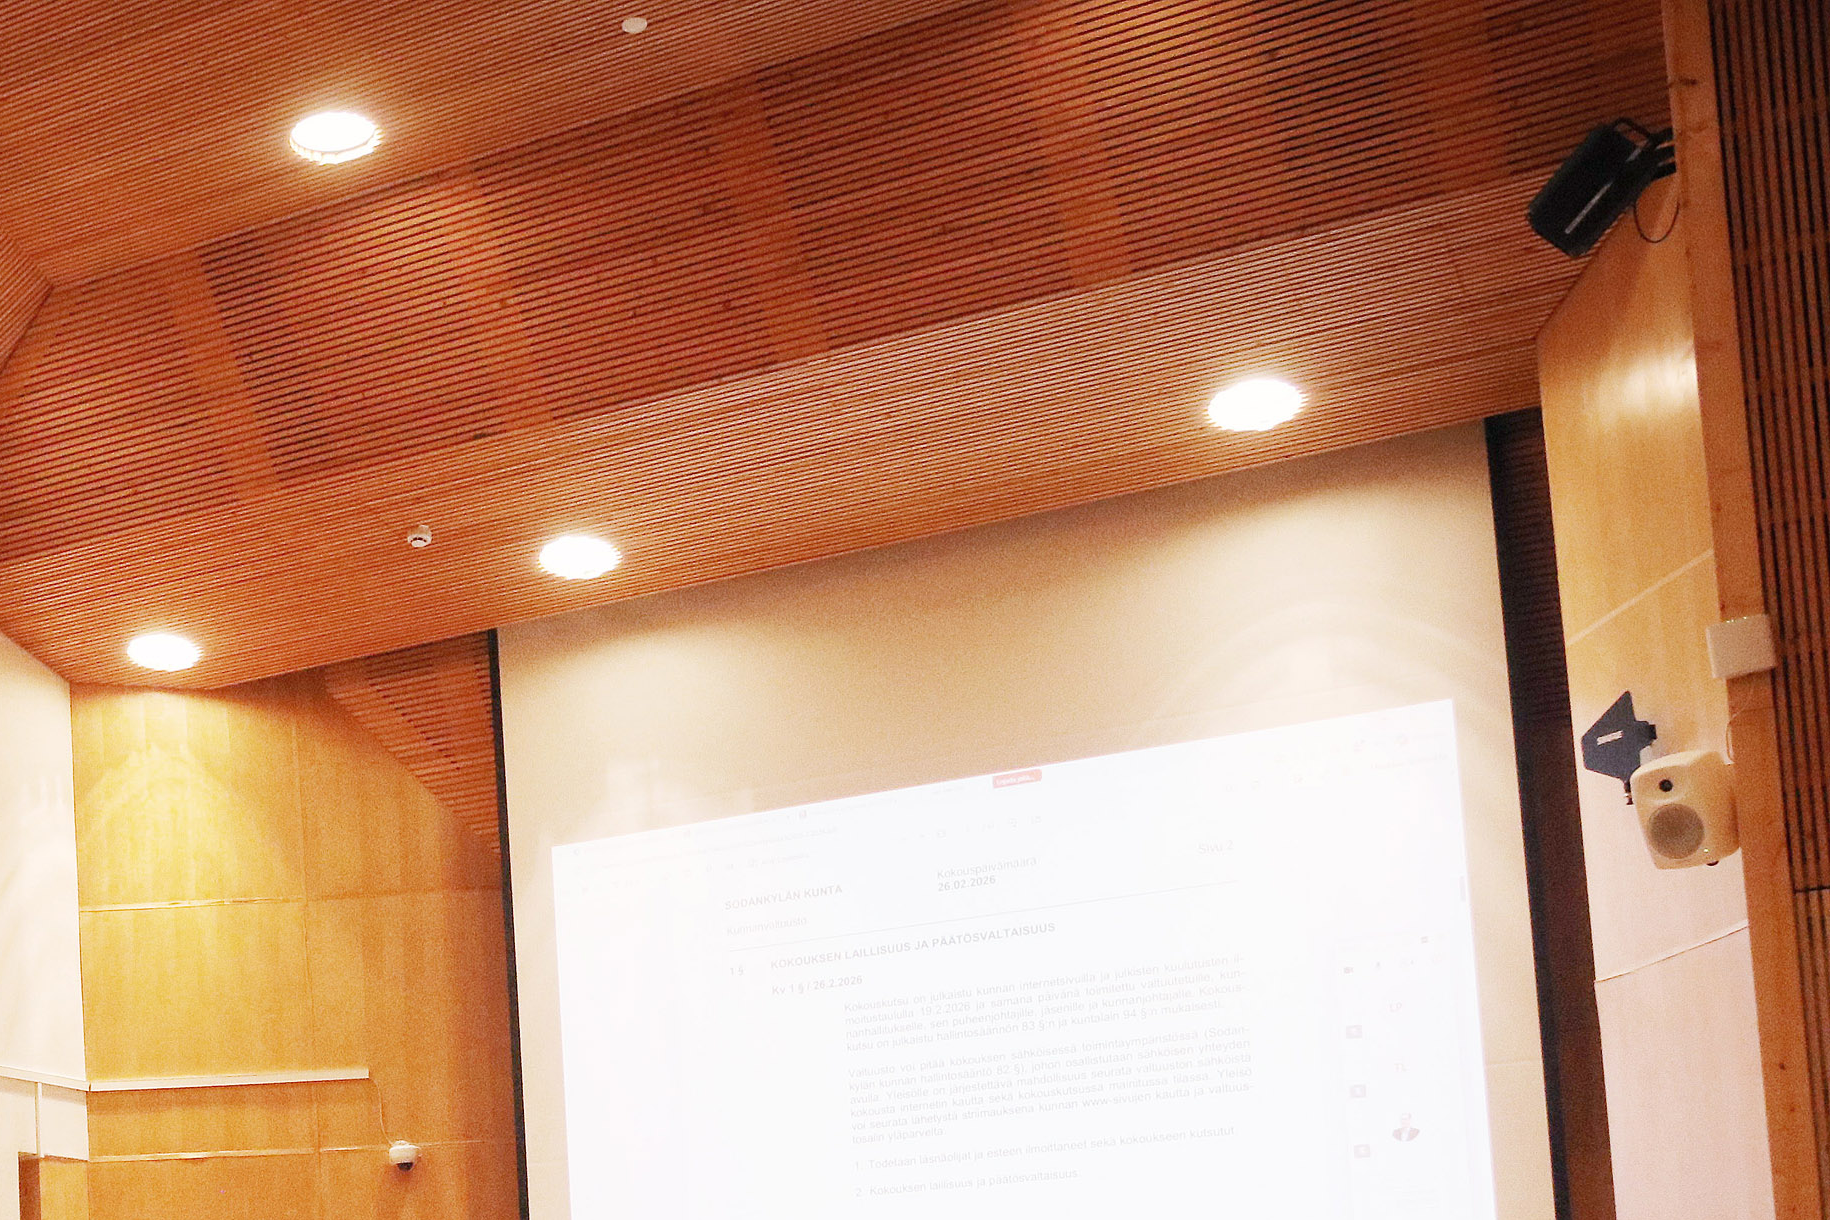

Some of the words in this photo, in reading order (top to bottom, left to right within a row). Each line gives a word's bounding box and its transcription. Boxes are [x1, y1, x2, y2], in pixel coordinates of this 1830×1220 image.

[937, 874, 995, 891] 26.02.2026
[724, 890, 800, 909] SODANKYLÄN
[803, 884, 842, 898] KUNTA
[770, 951, 841, 969] KOKOUKSEN
[844, 941, 910, 959] LAILLISUUS
